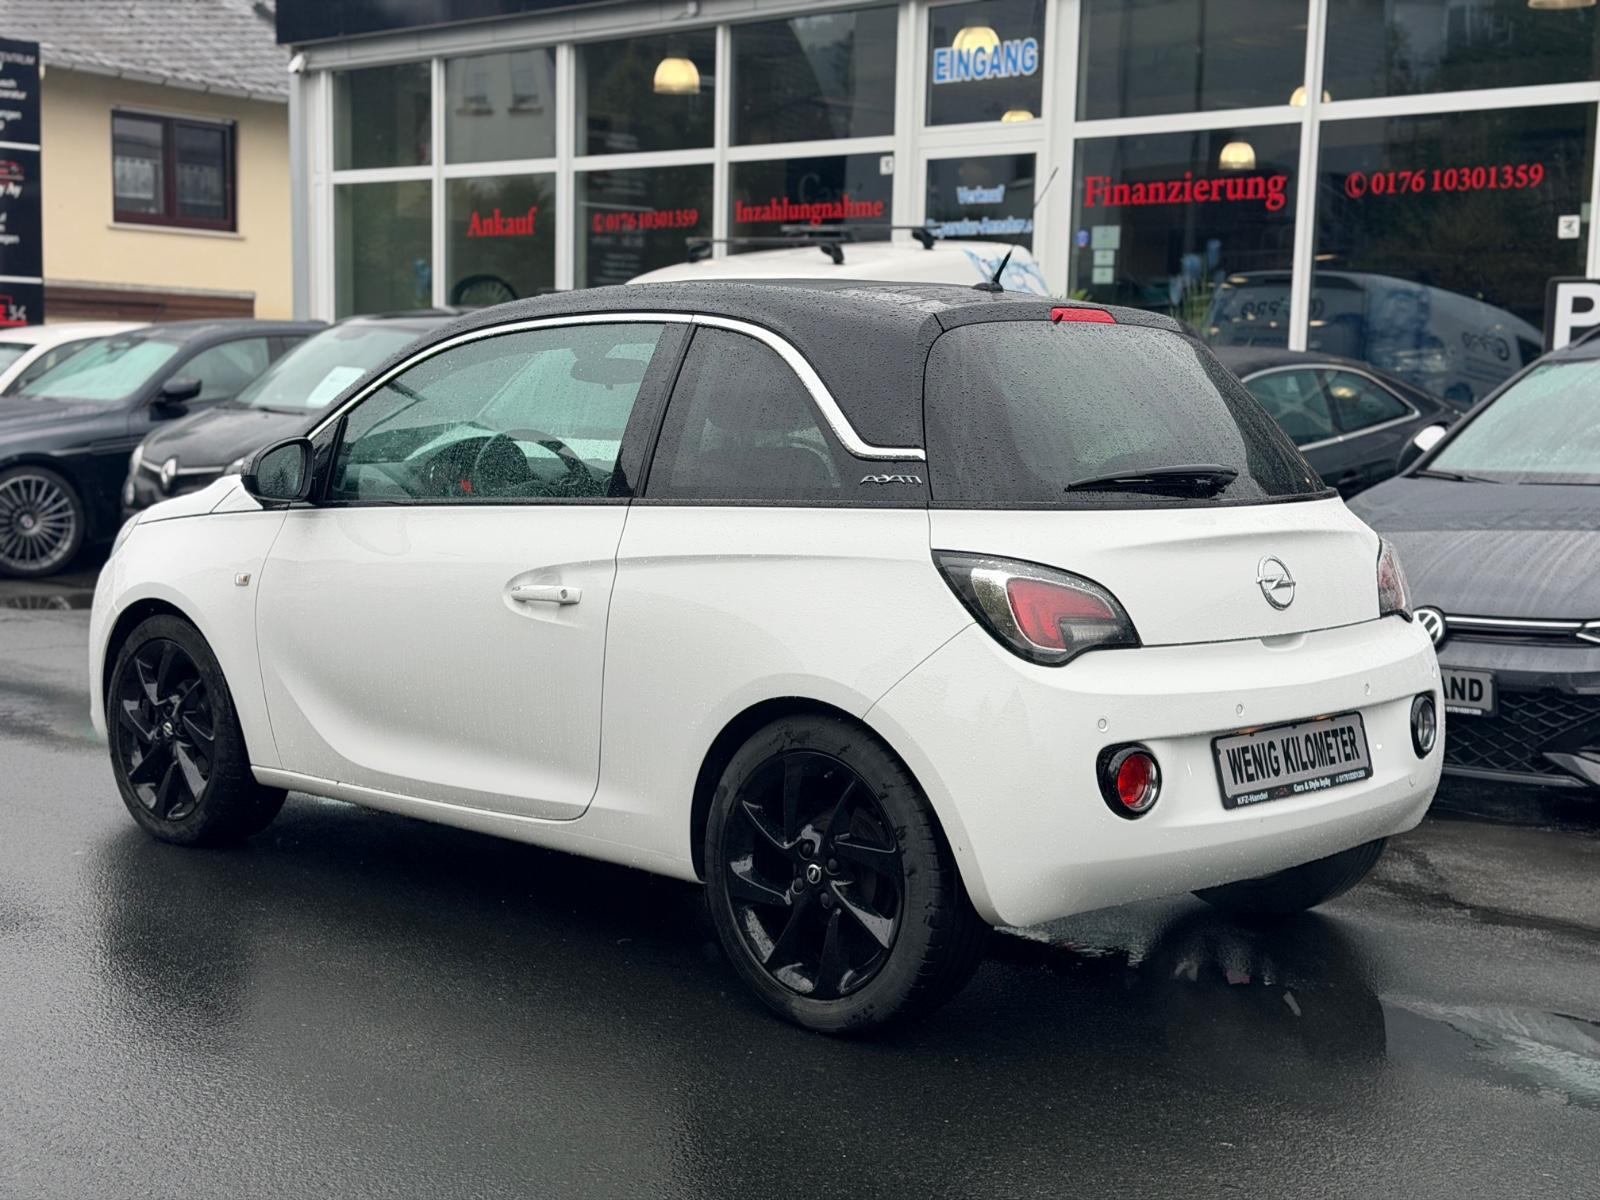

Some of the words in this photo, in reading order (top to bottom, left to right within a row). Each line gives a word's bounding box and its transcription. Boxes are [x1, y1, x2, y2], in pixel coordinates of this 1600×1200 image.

[934, 38, 1038, 83] EINGANG
[1084, 171, 1288, 211] Finanzierung
[1371, 169, 1426, 195] 0176
[1432, 163, 1545, 192] 10301359
[467, 206, 539, 238] Ankauf
[735, 192, 885, 228] Inzahlungnahme
[1226, 740, 1281, 786] WENIG
[1281, 726, 1361, 774] KILOMETER
